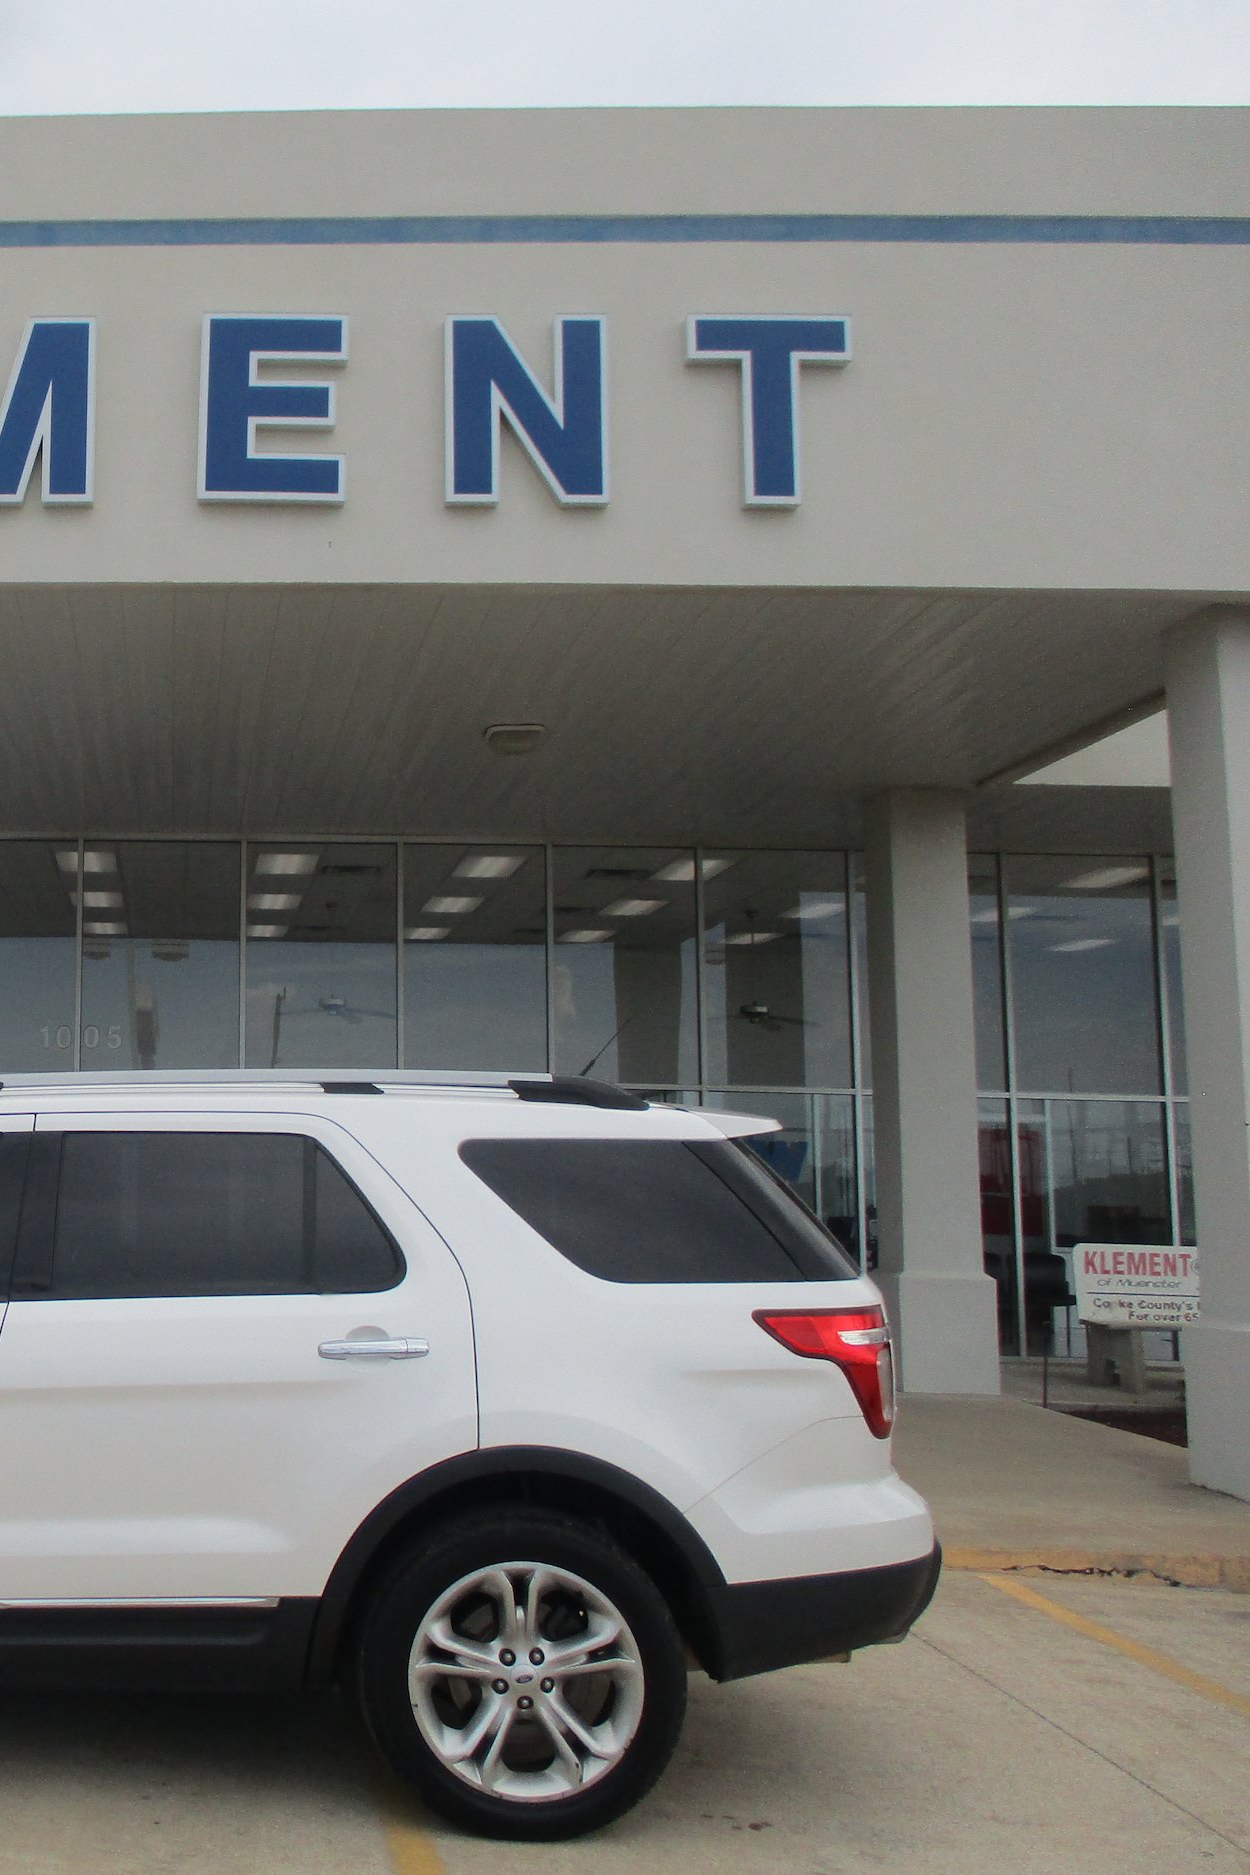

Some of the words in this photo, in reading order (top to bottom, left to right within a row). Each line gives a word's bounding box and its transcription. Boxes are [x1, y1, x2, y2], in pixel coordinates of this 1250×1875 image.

[40, 1025, 123, 1049] 1005
[1083, 1250, 1192, 1277] KLEMENT
[1137, 1300, 1193, 1312] County's
